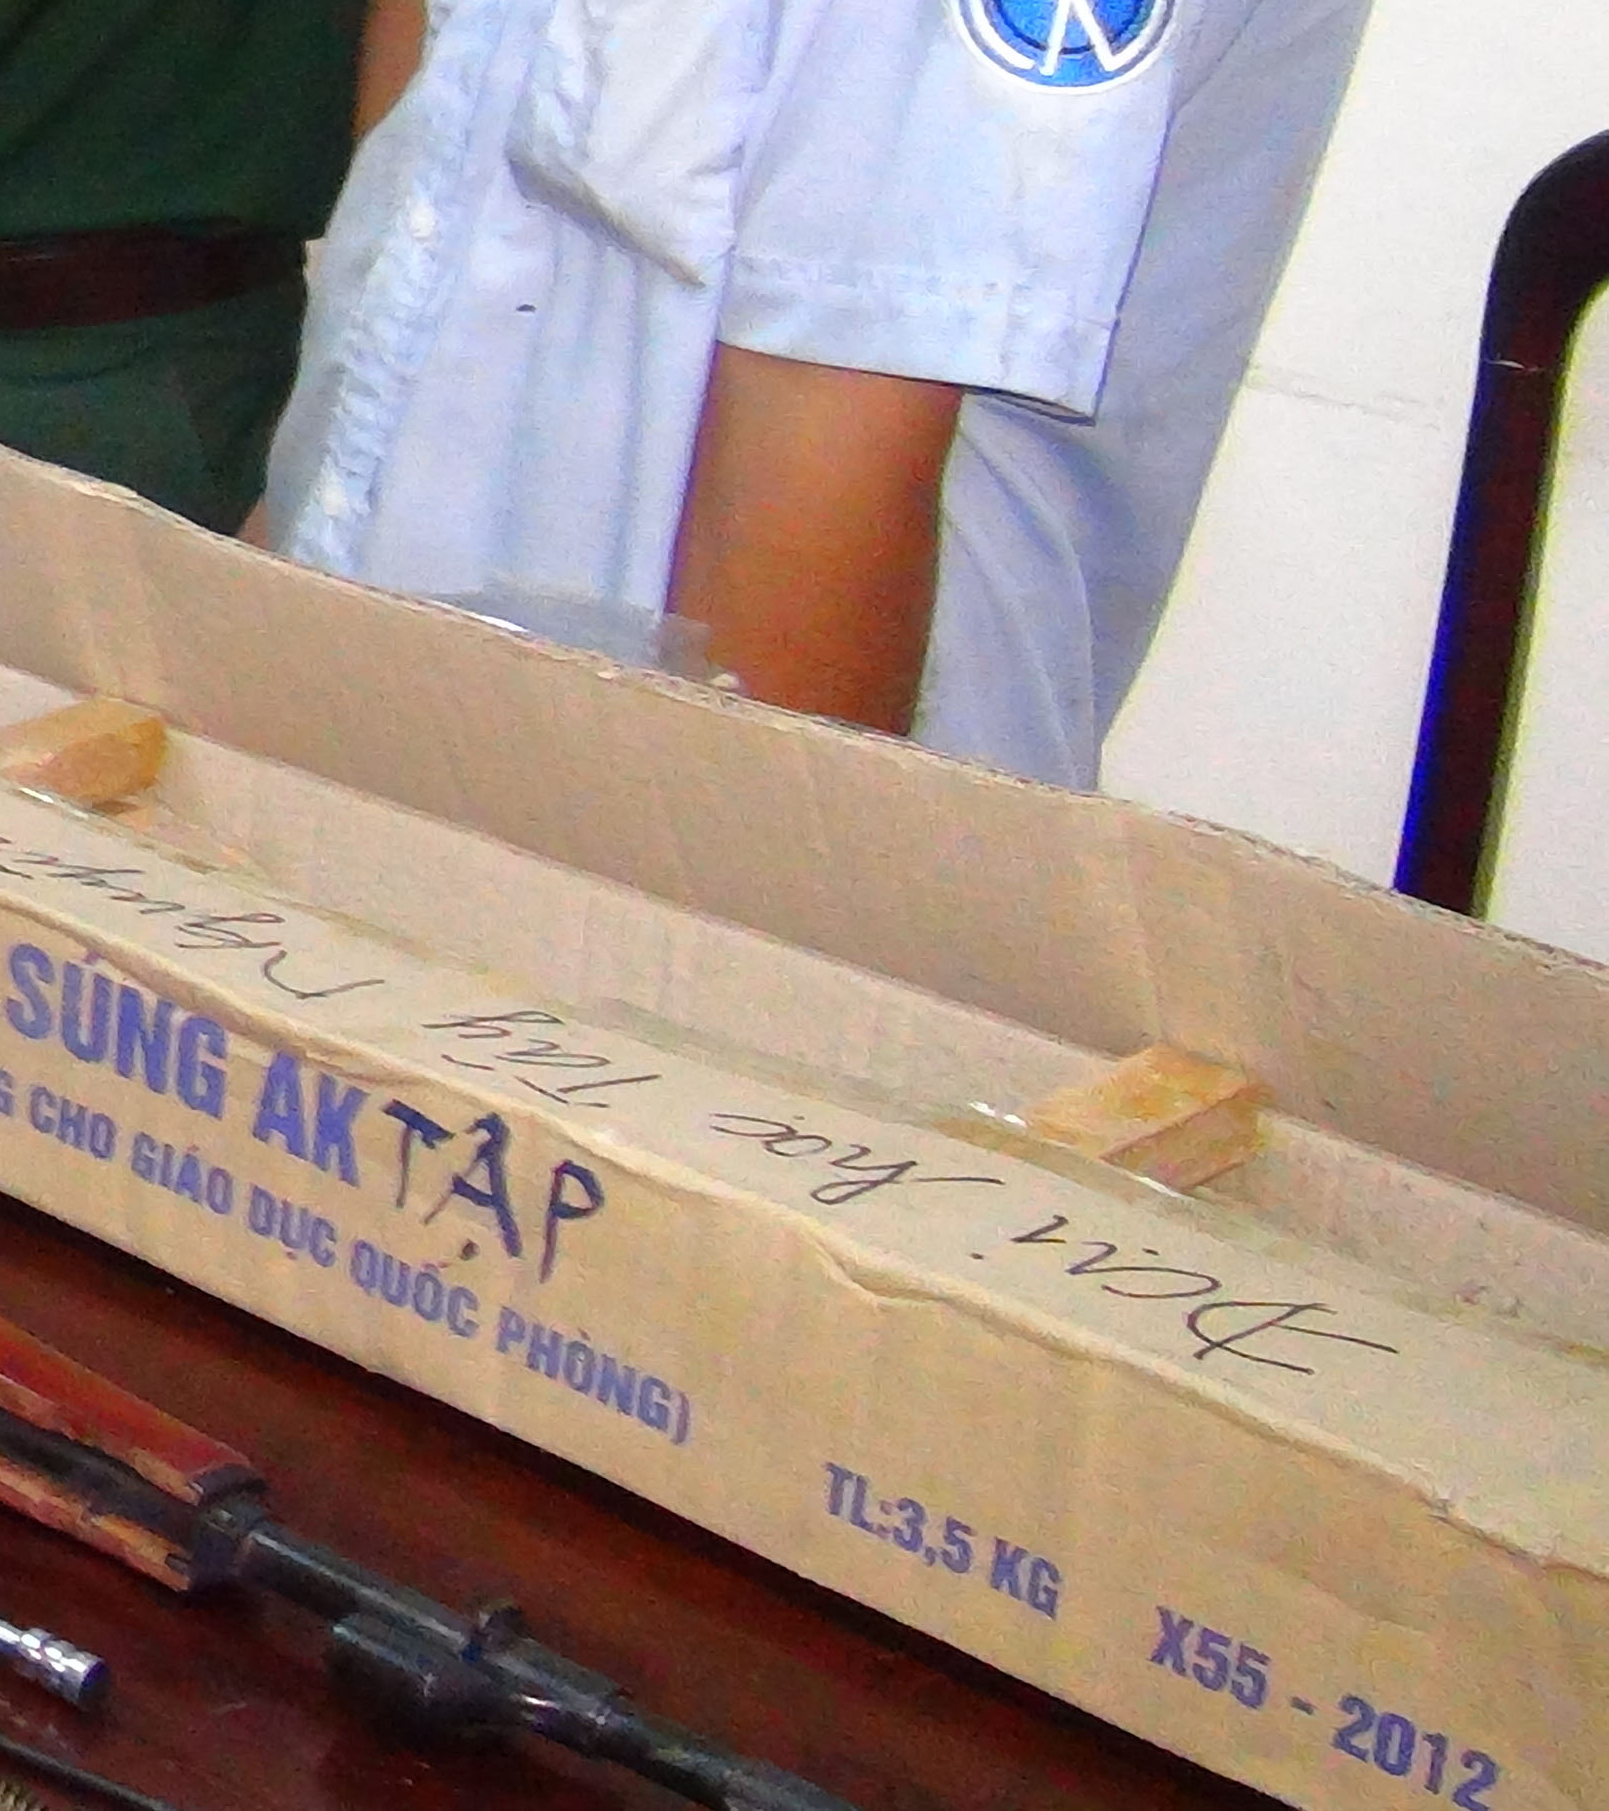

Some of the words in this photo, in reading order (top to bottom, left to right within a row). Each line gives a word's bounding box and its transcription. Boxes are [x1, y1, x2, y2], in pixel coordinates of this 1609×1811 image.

[5, 942, 229, 1120] SÚNG
[252, 1047, 370, 1188] AK
[28, 1085, 117, 1162] CHO
[131, 1131, 235, 1216] GIÁO
[247, 1183, 337, 1268] DỤC
[349, 1238, 482, 1338] QUỐC
[495, 1305, 691, 1446] PHÒNG)
[989, 1535, 1063, 1620] KG
[1148, 1605, 1272, 1713] X55
[1331, 1693, 1501, 1811] 2012
